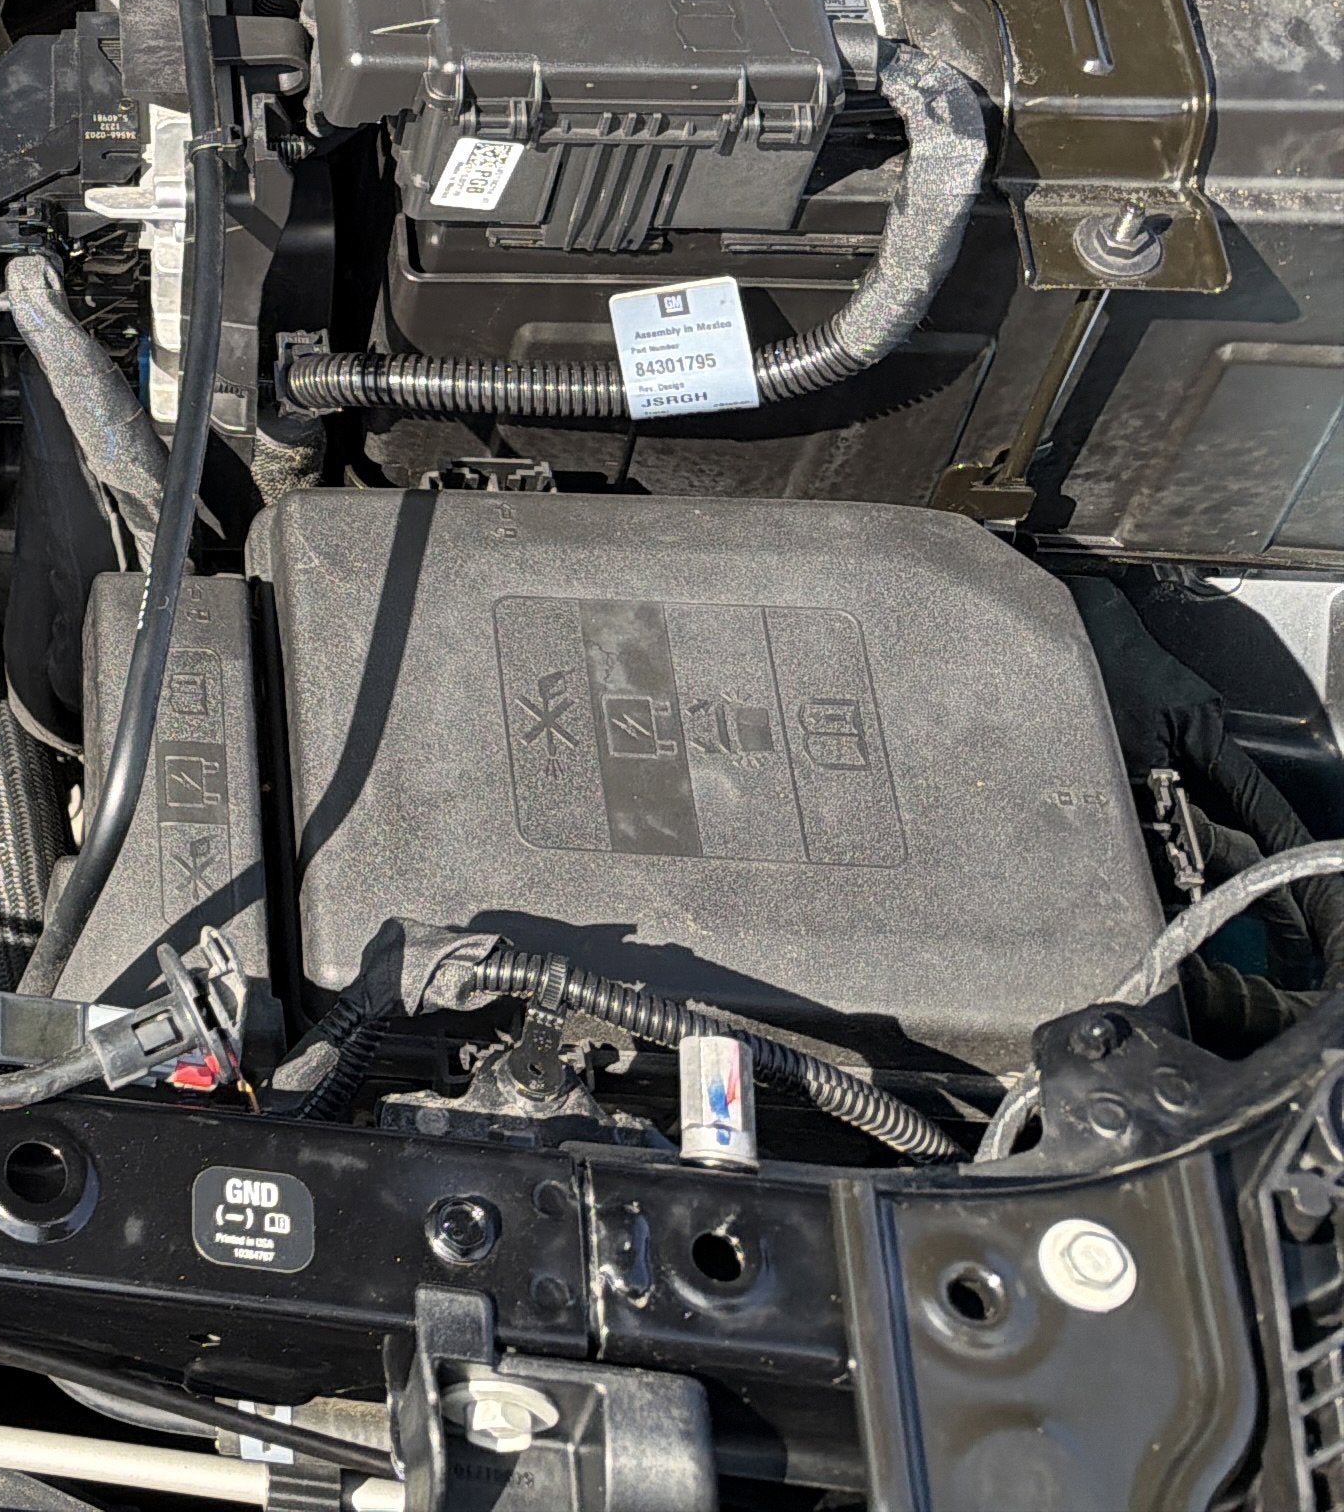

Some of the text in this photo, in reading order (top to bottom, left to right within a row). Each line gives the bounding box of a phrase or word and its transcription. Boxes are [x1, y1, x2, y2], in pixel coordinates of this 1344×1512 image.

[634, 320, 732, 340] Assembly in Mexico
[635, 353, 717, 377] 84301795
[641, 391, 708, 408] JSRGH
[225, 1178, 278, 1207] GND
